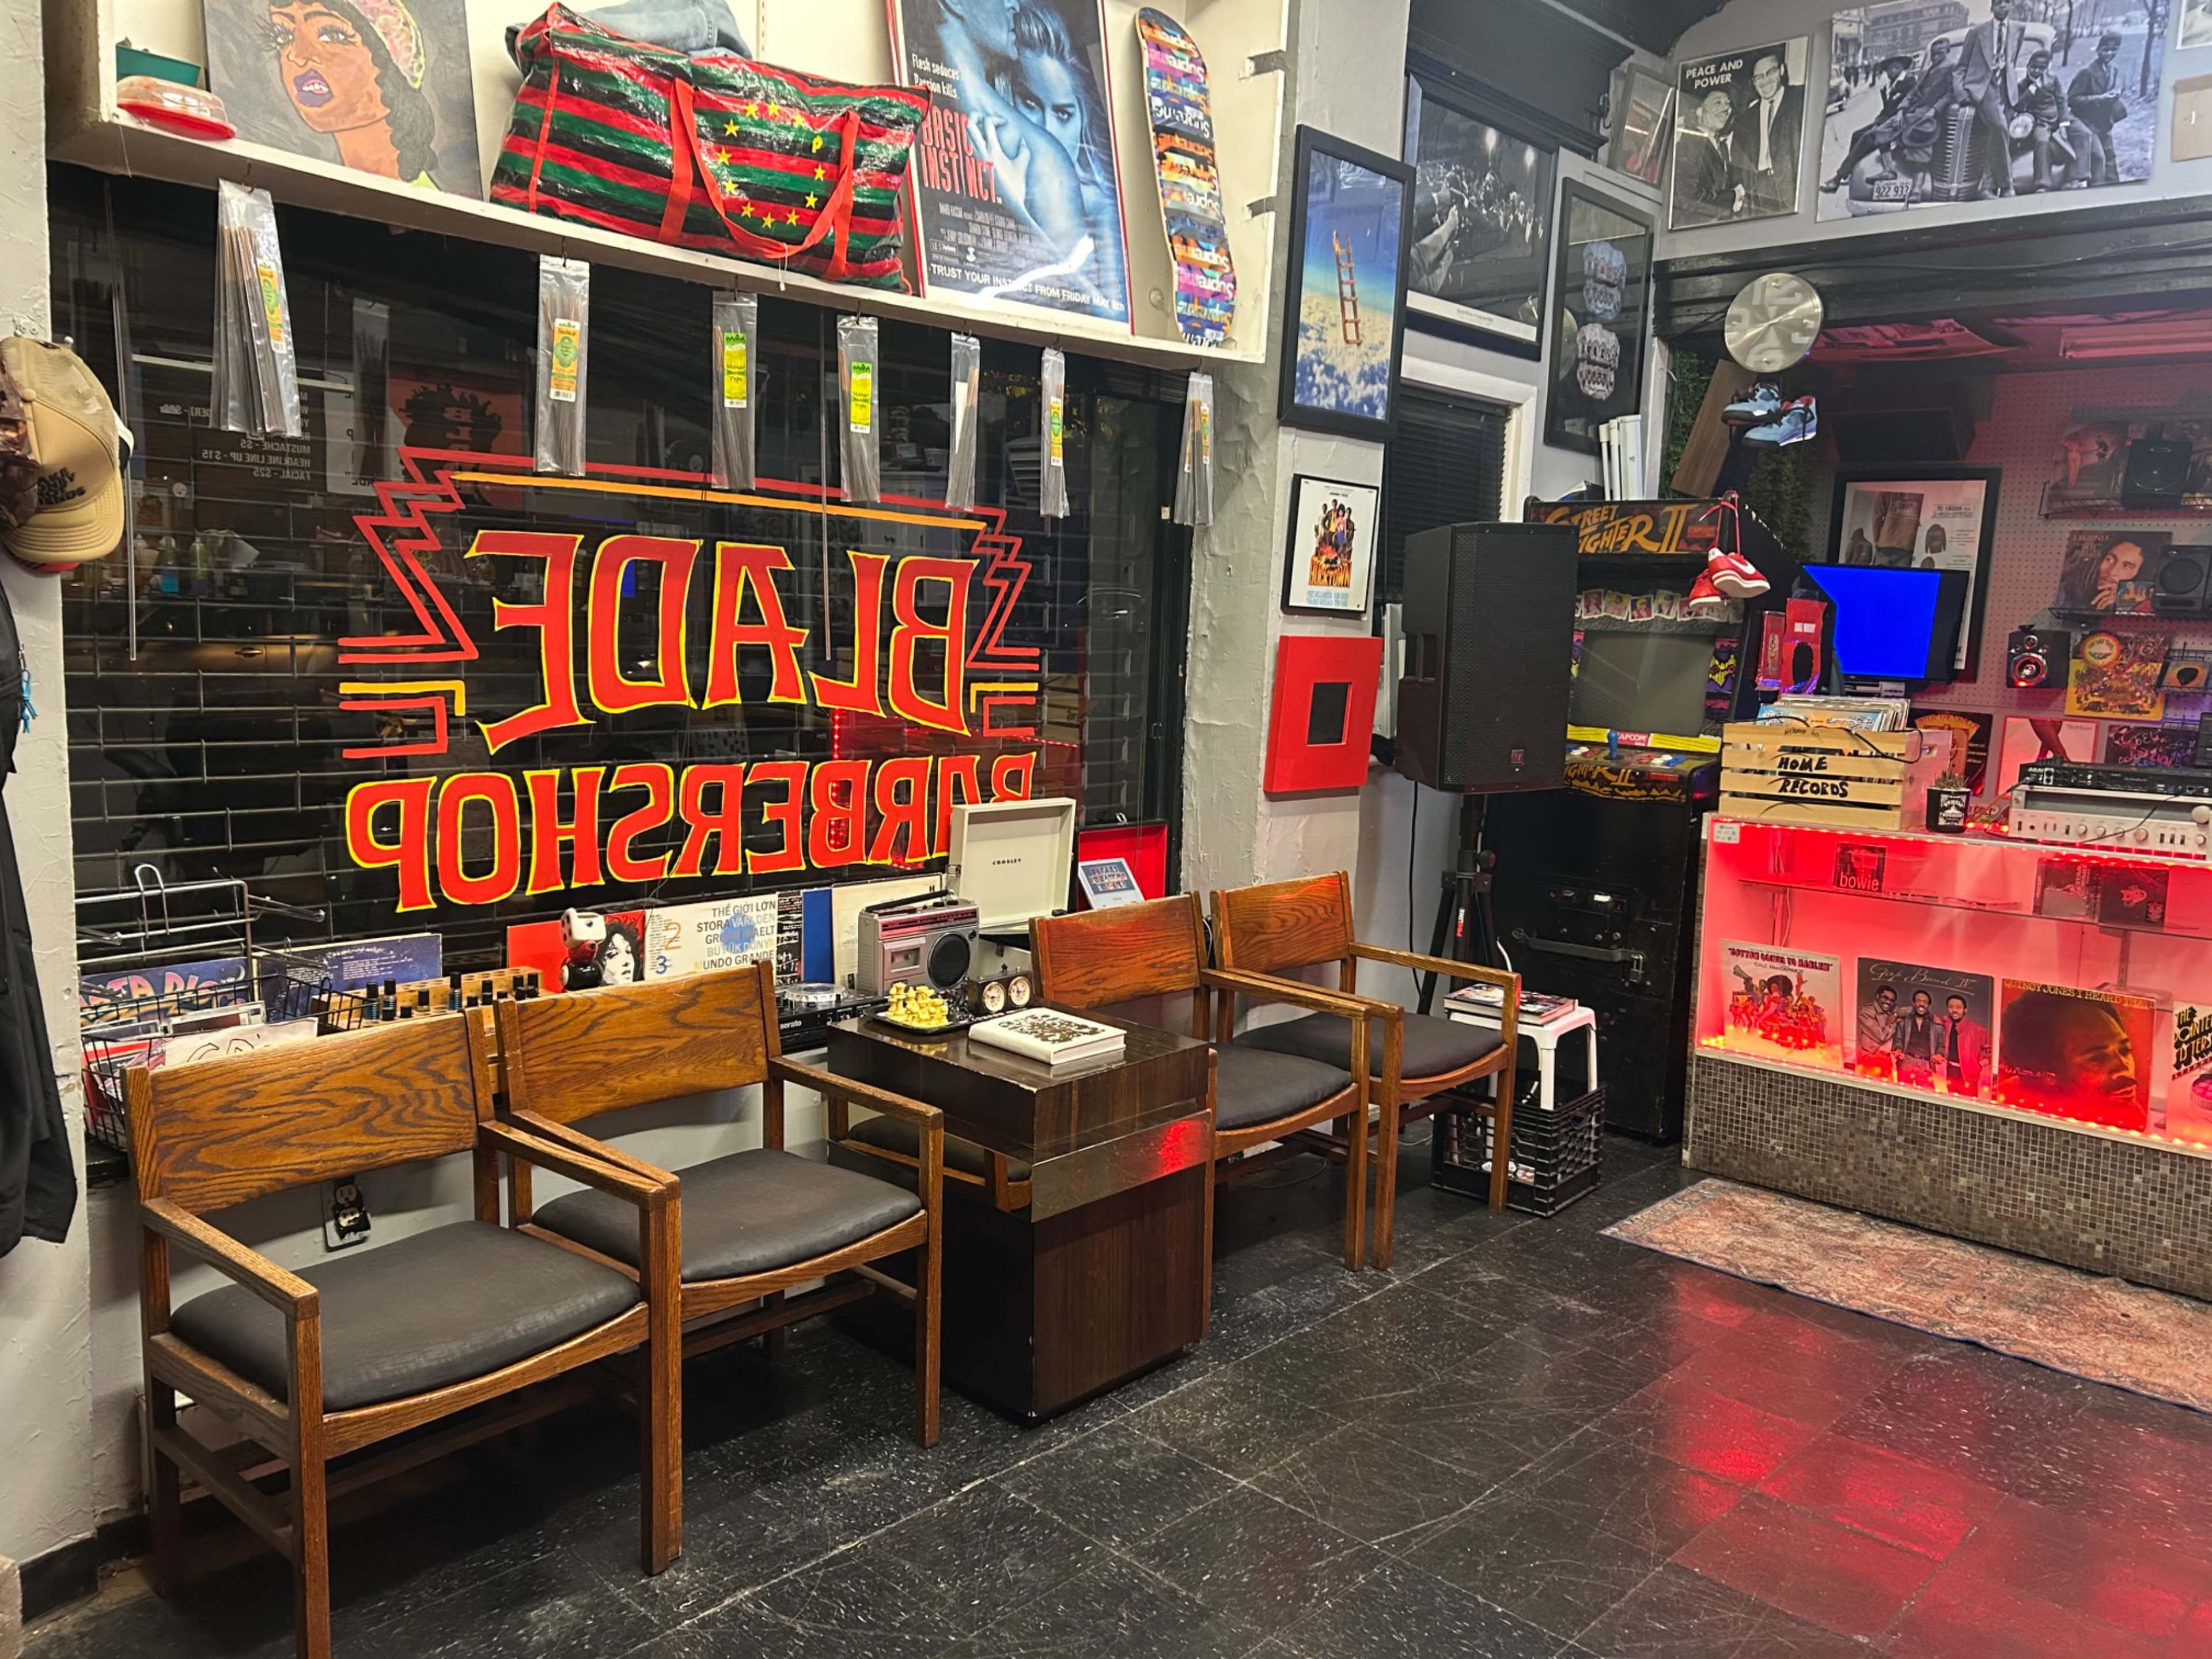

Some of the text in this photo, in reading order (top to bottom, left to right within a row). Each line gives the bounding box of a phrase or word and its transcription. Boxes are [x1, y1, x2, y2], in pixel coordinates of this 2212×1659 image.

[912, 54, 960, 81] Flesh seduces
[1685, 59, 1743, 79] PEACE AND
[1694, 73, 1732, 89] POWER
[923, 105, 973, 157] BASIC
[920, 144, 996, 203] INSTINCT
[931, 264, 962, 280] TRUST
[964, 270, 990, 285] YOUR
[993, 275, 1035, 294] INSTCT
[1035, 284, 1060, 298] FROM
[1062, 289, 1091, 305] FRIDAY
[1579, 505, 1699, 554] IGHTER II
[1778, 756, 1827, 772] HOME
[1778, 778, 1849, 798] RECORDS
[993, 858, 1022, 866] CROSLEY
[1840, 871, 1880, 891] bowie
[664, 921, 682, 951] 2
[697, 920, 730, 933] STORA
[656, 955, 668, 975] 3
[694, 950, 775, 972] MUNDO GRANDE
[1870, 963, 1901, 982] Gap
[1903, 967, 1952, 986] Band
[2004, 979, 2042, 993] QUINCY
[2043, 984, 2074, 997] JONES
[2075, 989, 2083, 998] I
[2084, 990, 2122, 1004] HEARD
[780, 1020, 802, 1030] serato
